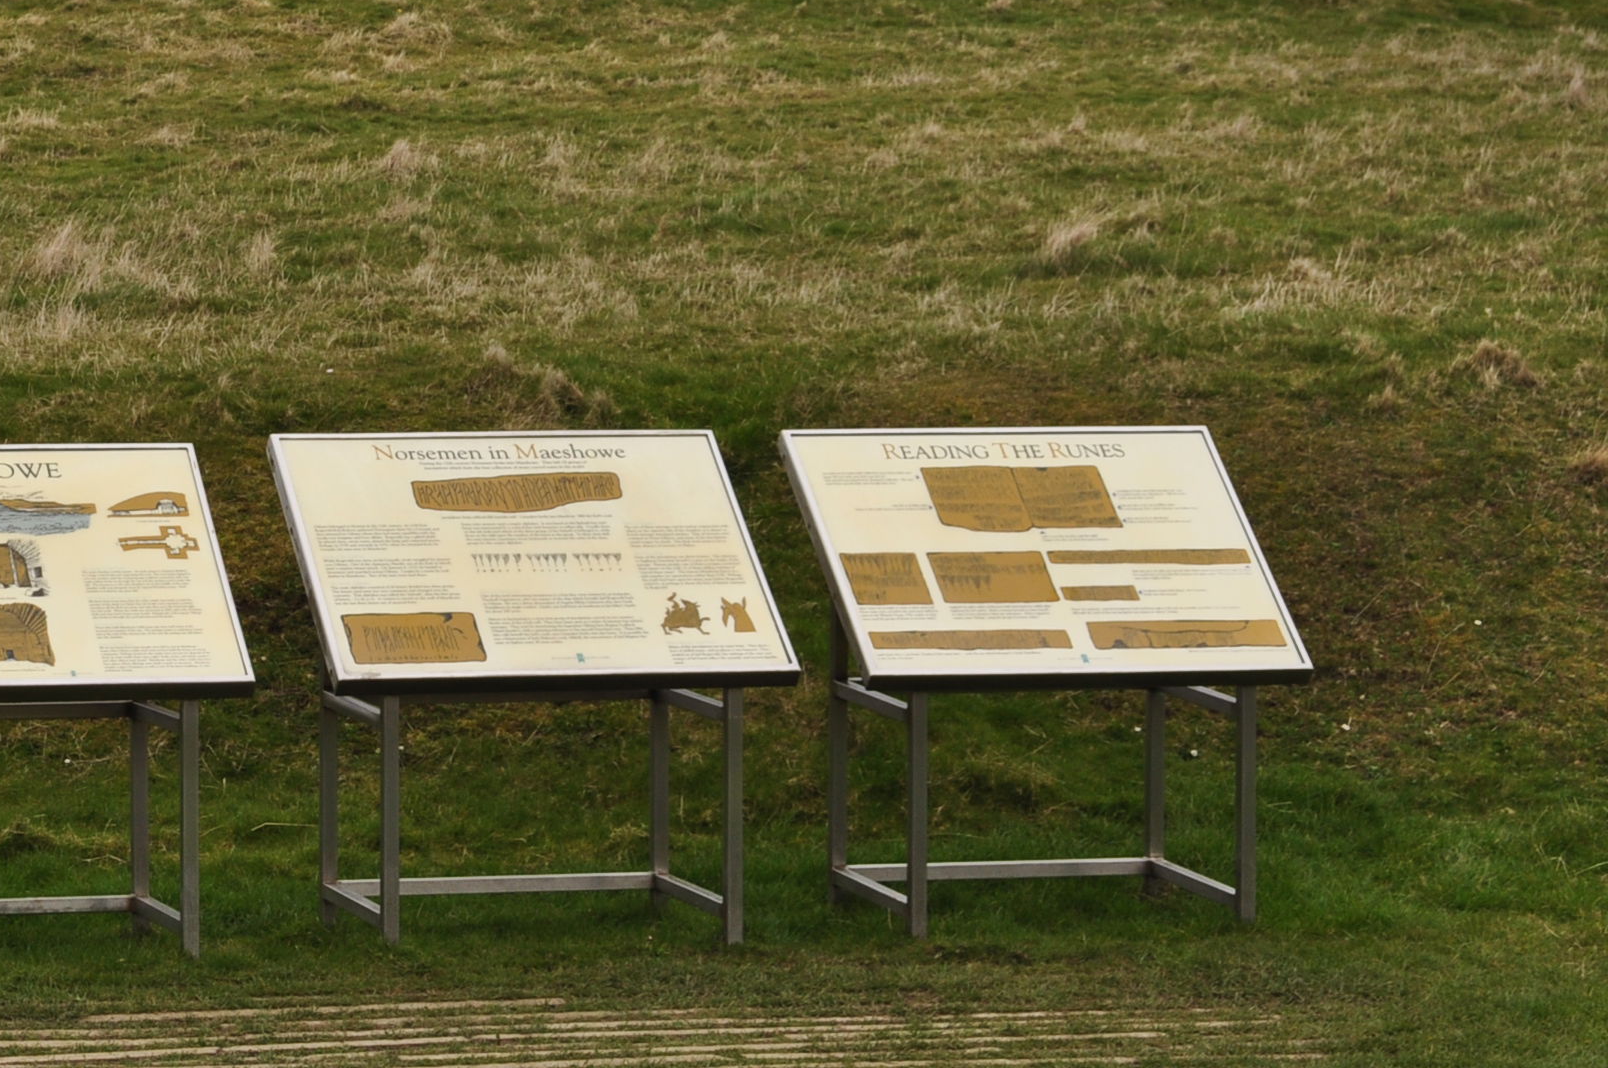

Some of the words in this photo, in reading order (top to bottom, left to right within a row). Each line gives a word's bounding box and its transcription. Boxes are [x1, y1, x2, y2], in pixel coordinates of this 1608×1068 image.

[372, 444, 482, 461] Norsemen
[489, 445, 509, 460] in
[514, 443, 626, 460] Maeshowe
[881, 442, 990, 460] READING
[992, 442, 1045, 460] THE
[1048, 441, 1126, 459] RUNES
